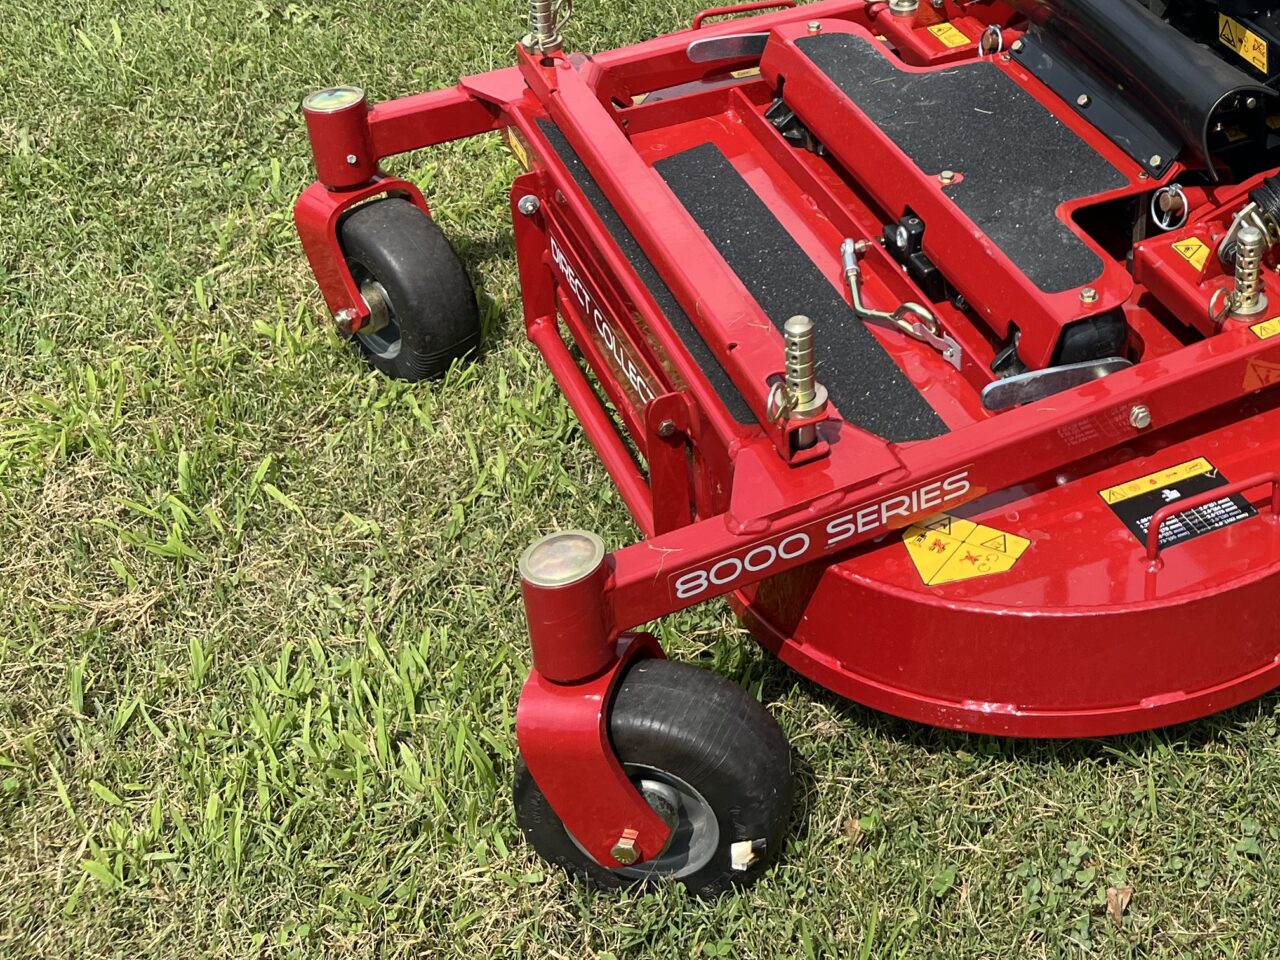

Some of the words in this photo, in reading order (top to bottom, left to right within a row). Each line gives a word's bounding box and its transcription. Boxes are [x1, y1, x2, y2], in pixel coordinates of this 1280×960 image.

[550, 236, 591, 315] DIRECT
[674, 532, 811, 600] 8000
[825, 470, 971, 545] SERIES
